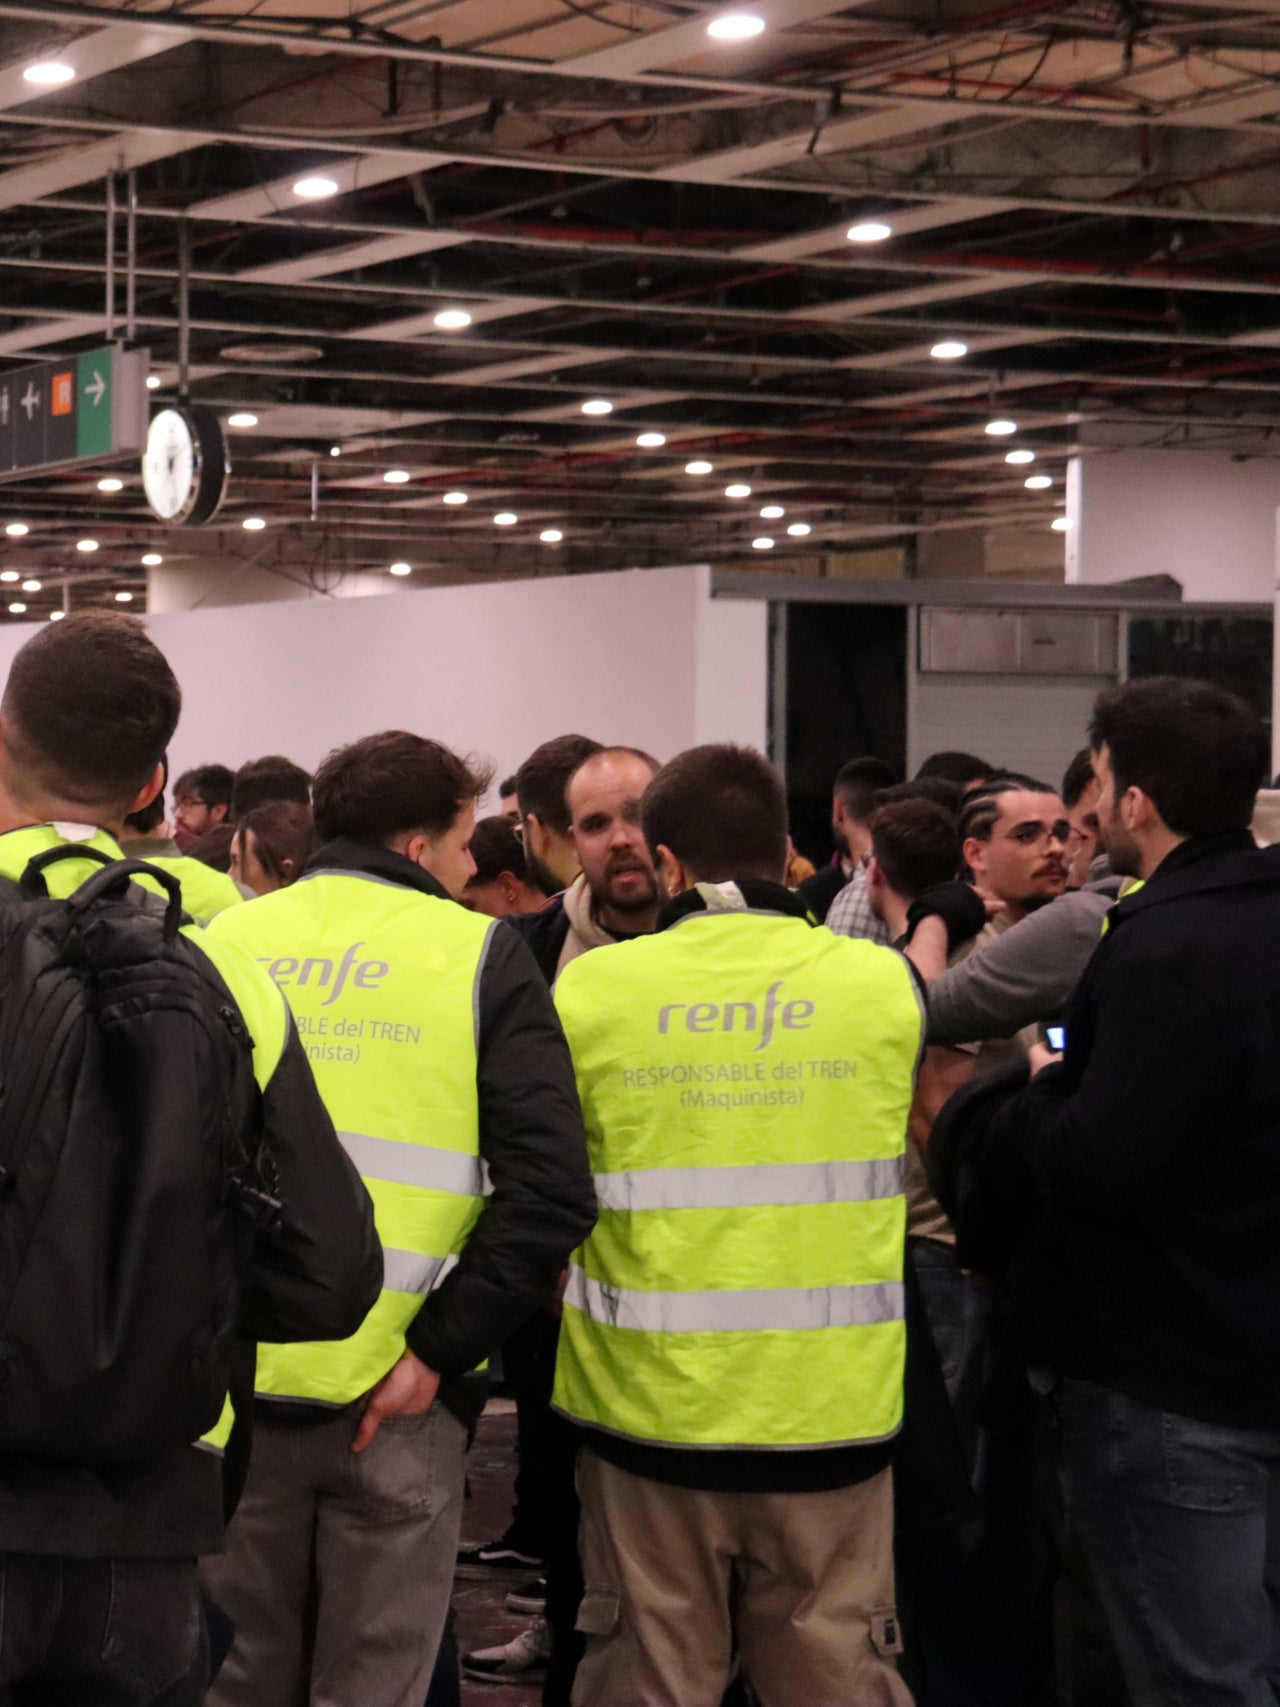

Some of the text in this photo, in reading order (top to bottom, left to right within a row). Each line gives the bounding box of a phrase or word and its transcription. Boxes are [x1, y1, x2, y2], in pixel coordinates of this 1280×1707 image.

[658, 981, 815, 1051] renfe
[334, 1017, 364, 1037] del
[369, 1021, 421, 1044] TREN
[623, 1060, 857, 1087] RESPONSABLE del TREN
[680, 1087, 805, 1111] (Maquinista)
